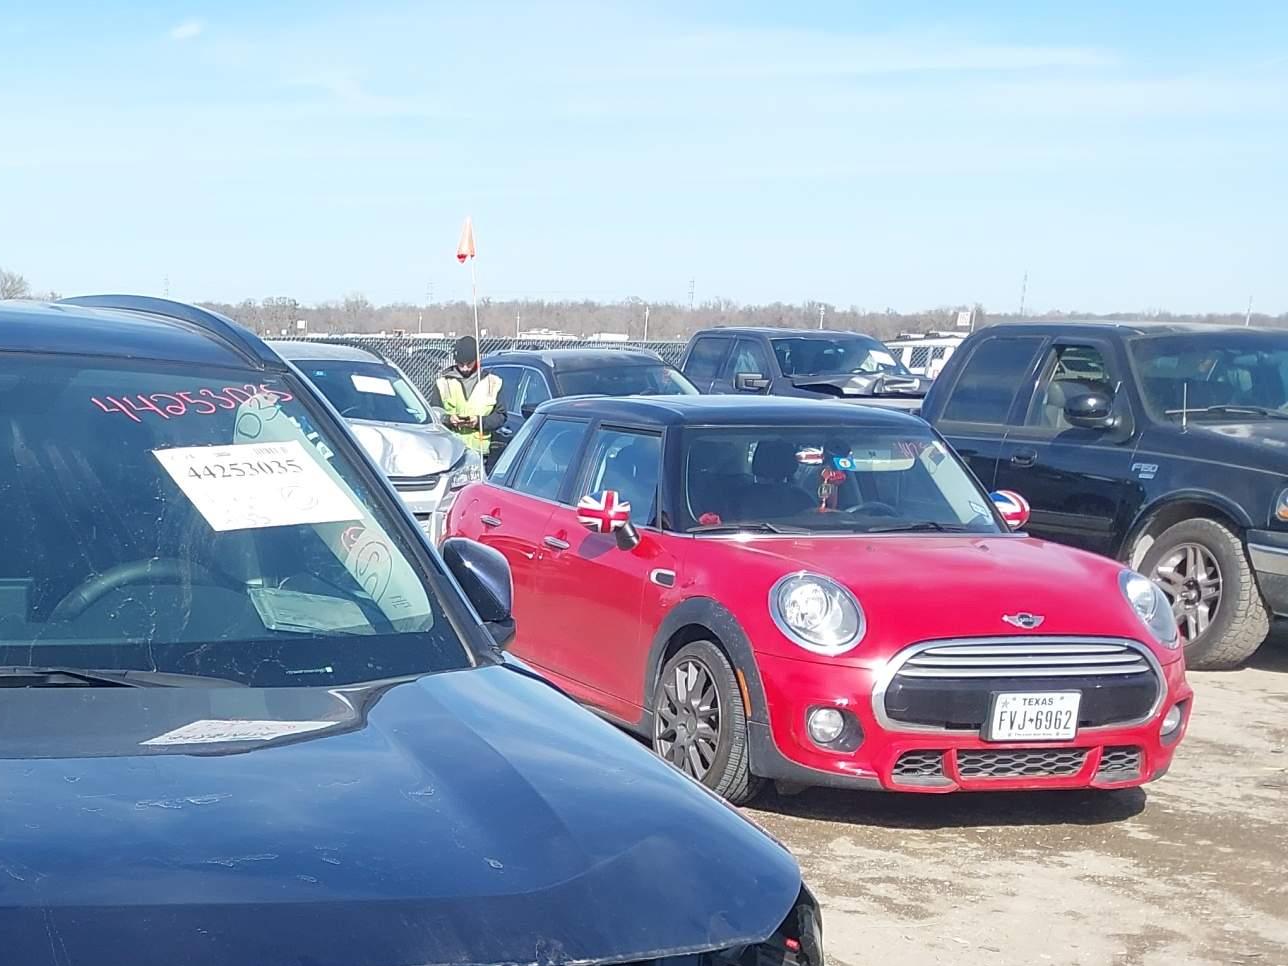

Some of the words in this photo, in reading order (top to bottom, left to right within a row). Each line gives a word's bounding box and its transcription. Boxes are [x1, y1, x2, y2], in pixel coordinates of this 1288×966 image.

[91, 384, 294, 423] 44253035
[187, 459, 304, 480] 44253035
[1131, 462, 1159, 473] F150
[1022, 697, 1055, 706] TEXAS
